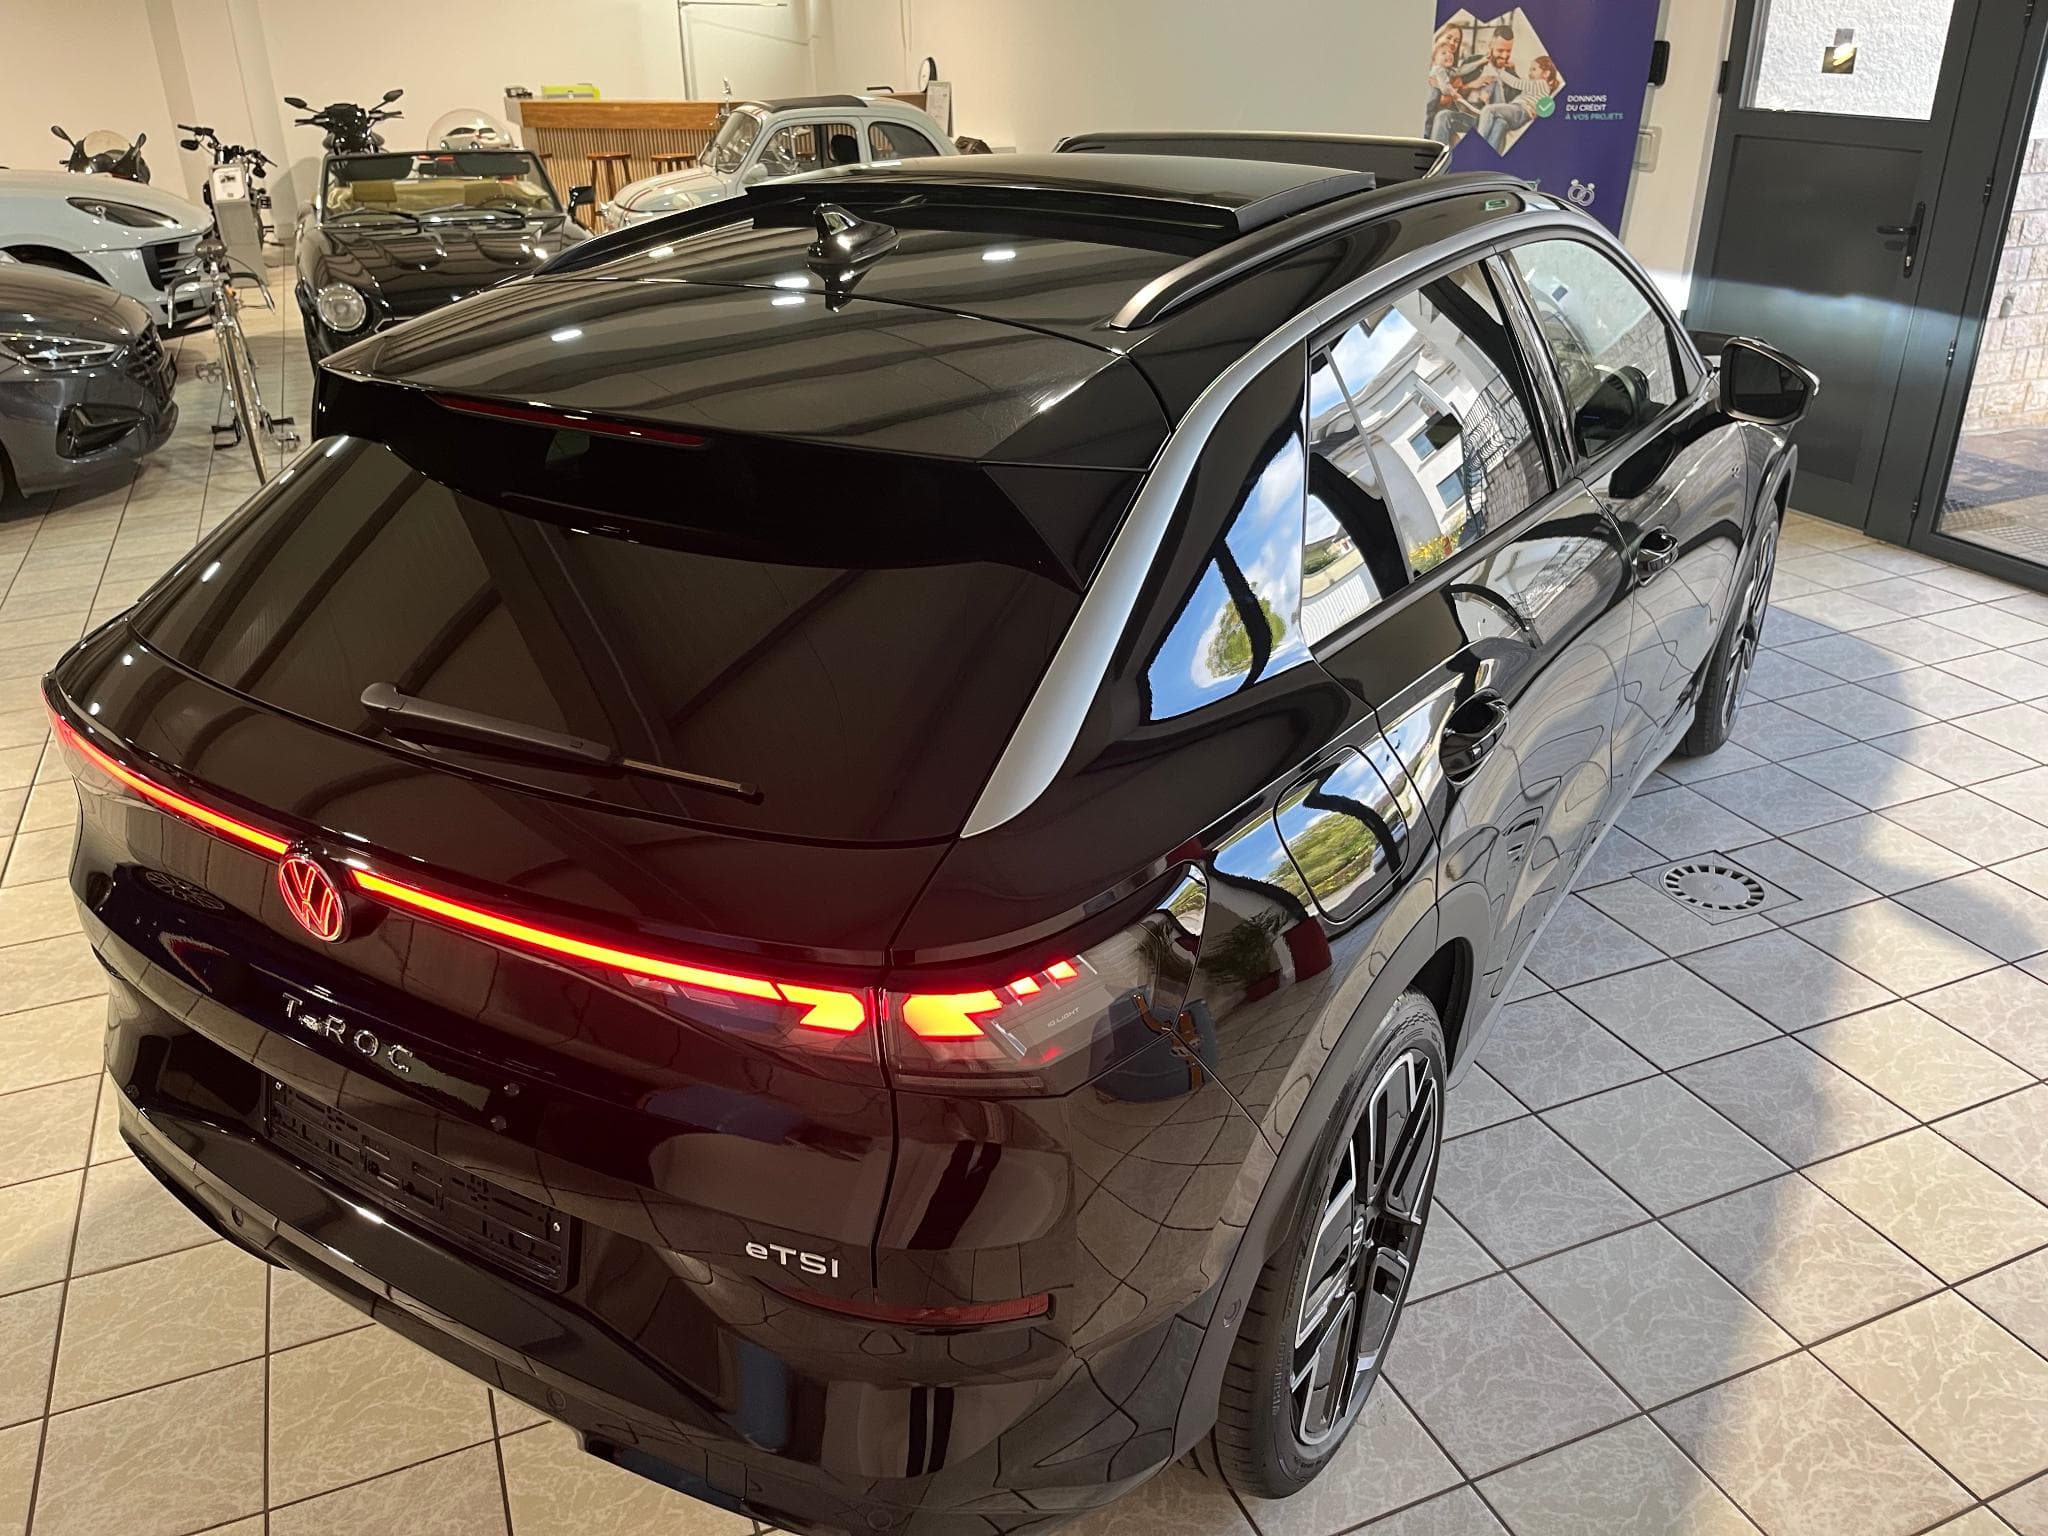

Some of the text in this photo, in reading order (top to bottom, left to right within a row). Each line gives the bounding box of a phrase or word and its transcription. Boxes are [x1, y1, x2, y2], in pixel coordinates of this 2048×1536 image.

[1579, 103, 1607, 111] CRÉDIT
[1590, 112, 1624, 120] PROJETS
[745, 1242, 838, 1278] eTSI
